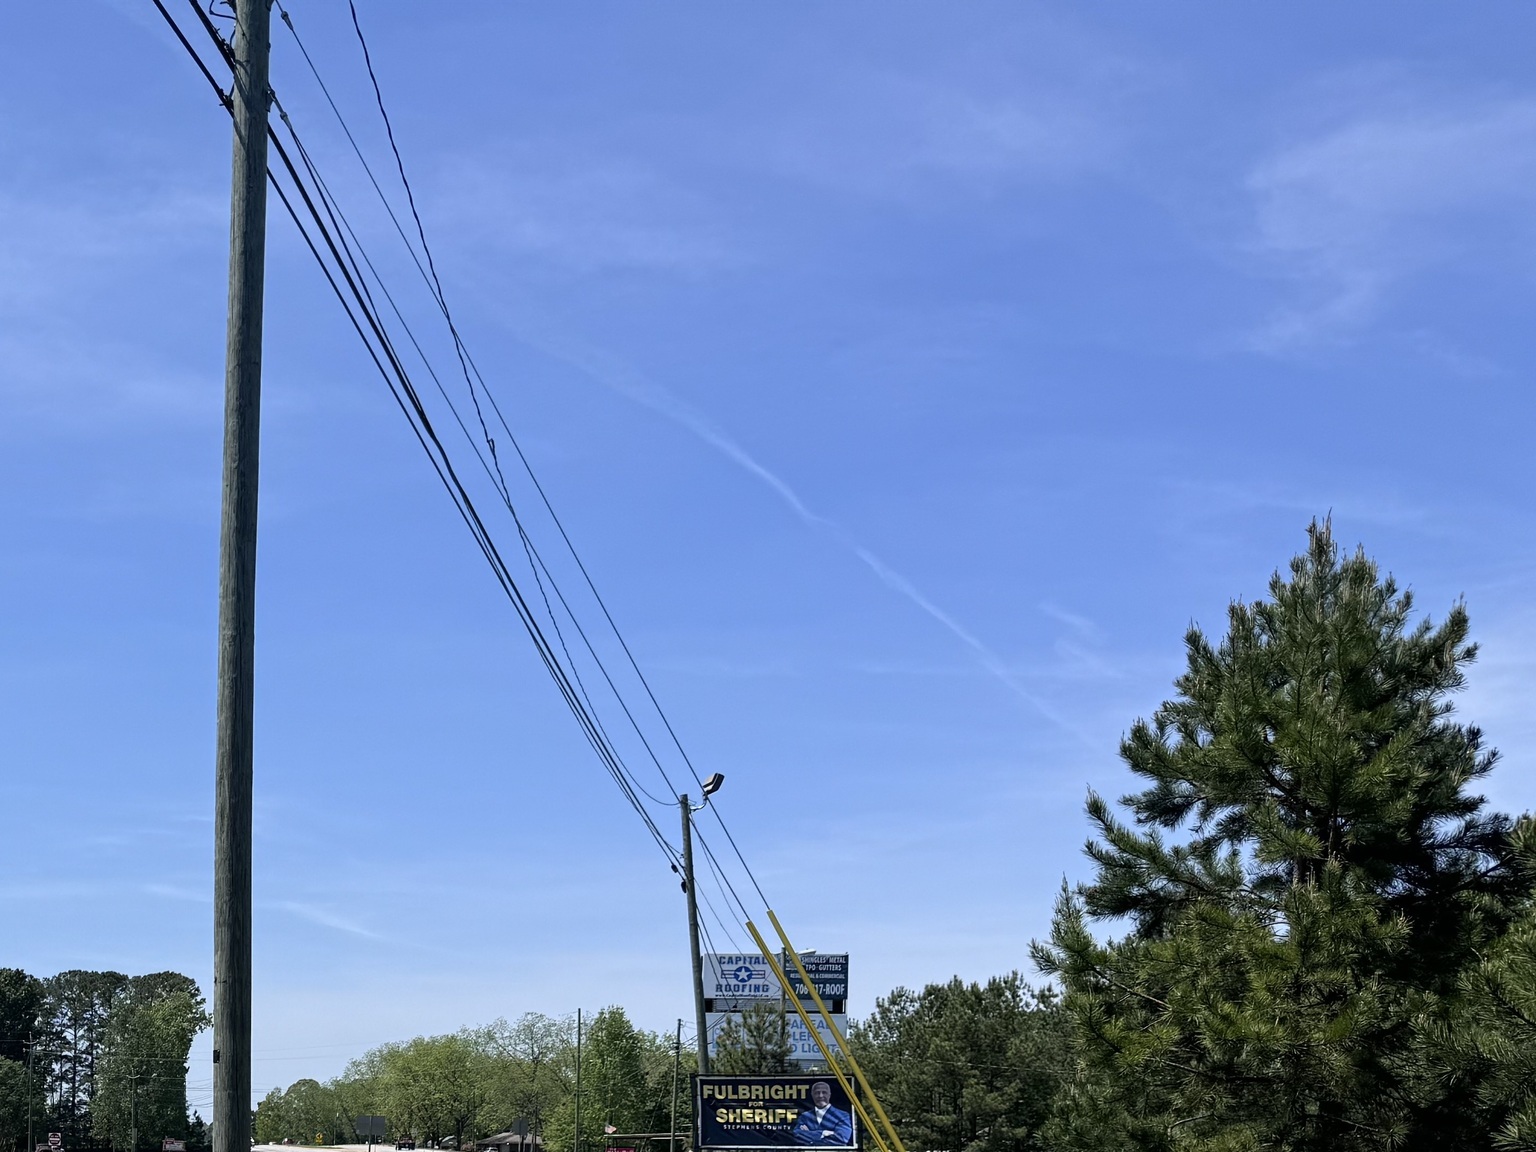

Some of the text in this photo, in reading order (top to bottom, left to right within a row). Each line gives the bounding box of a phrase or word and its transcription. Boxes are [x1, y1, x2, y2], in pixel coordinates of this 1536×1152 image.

[719, 956, 767, 965] CAPITAL
[715, 984, 770, 993] ROOFING
[703, 1085, 810, 1099] FULBRIGHT
[716, 1108, 798, 1123] SHERIFF
